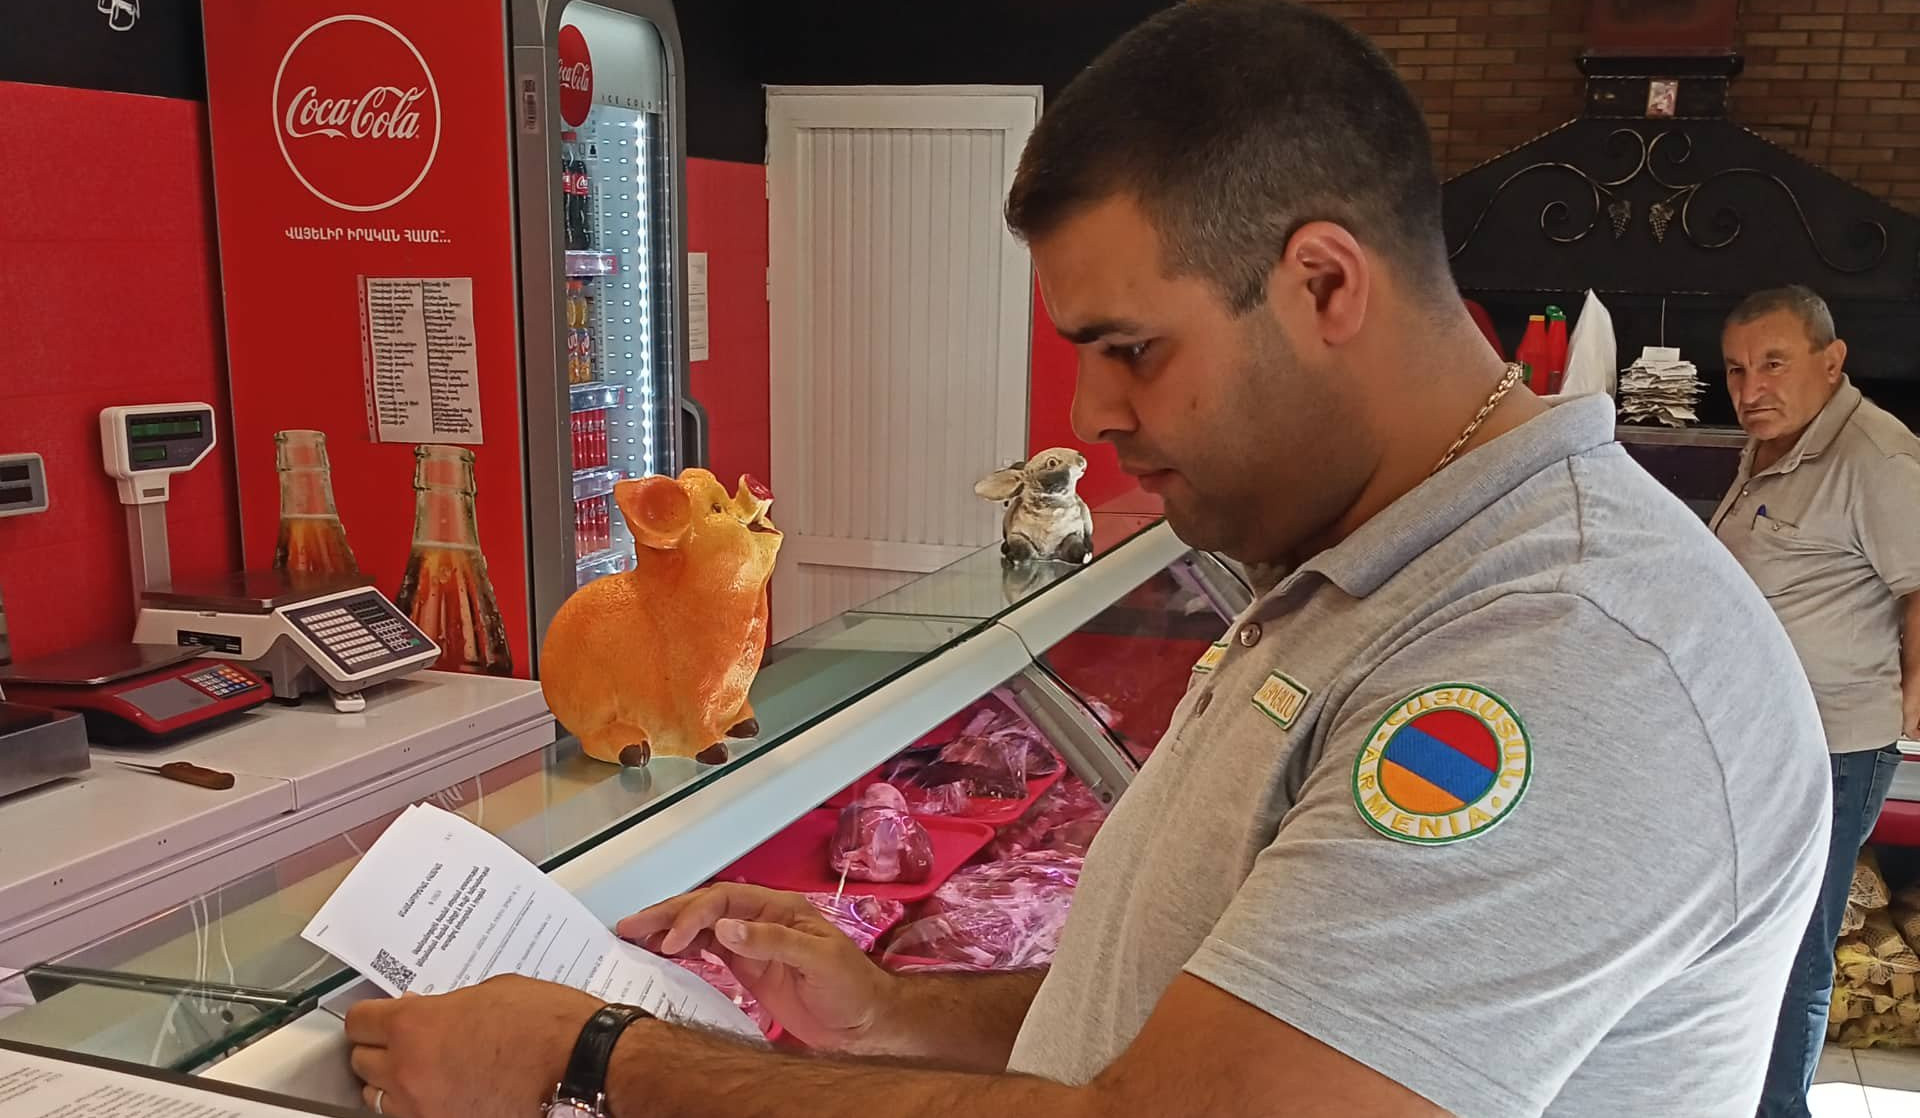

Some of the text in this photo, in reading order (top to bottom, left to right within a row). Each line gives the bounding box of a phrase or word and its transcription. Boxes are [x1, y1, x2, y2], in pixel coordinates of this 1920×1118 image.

[285, 86, 427, 139] Coca-Cola
[285, 226, 344, 241] ՎԱՅԵԼԻՐ
[347, 227, 401, 243] ԻՐԱԿԱՆ
[1386, 688, 1525, 789] ՀԱՅԱՍՏԱՆ
[1359, 746, 1494, 838] ARMENIA
